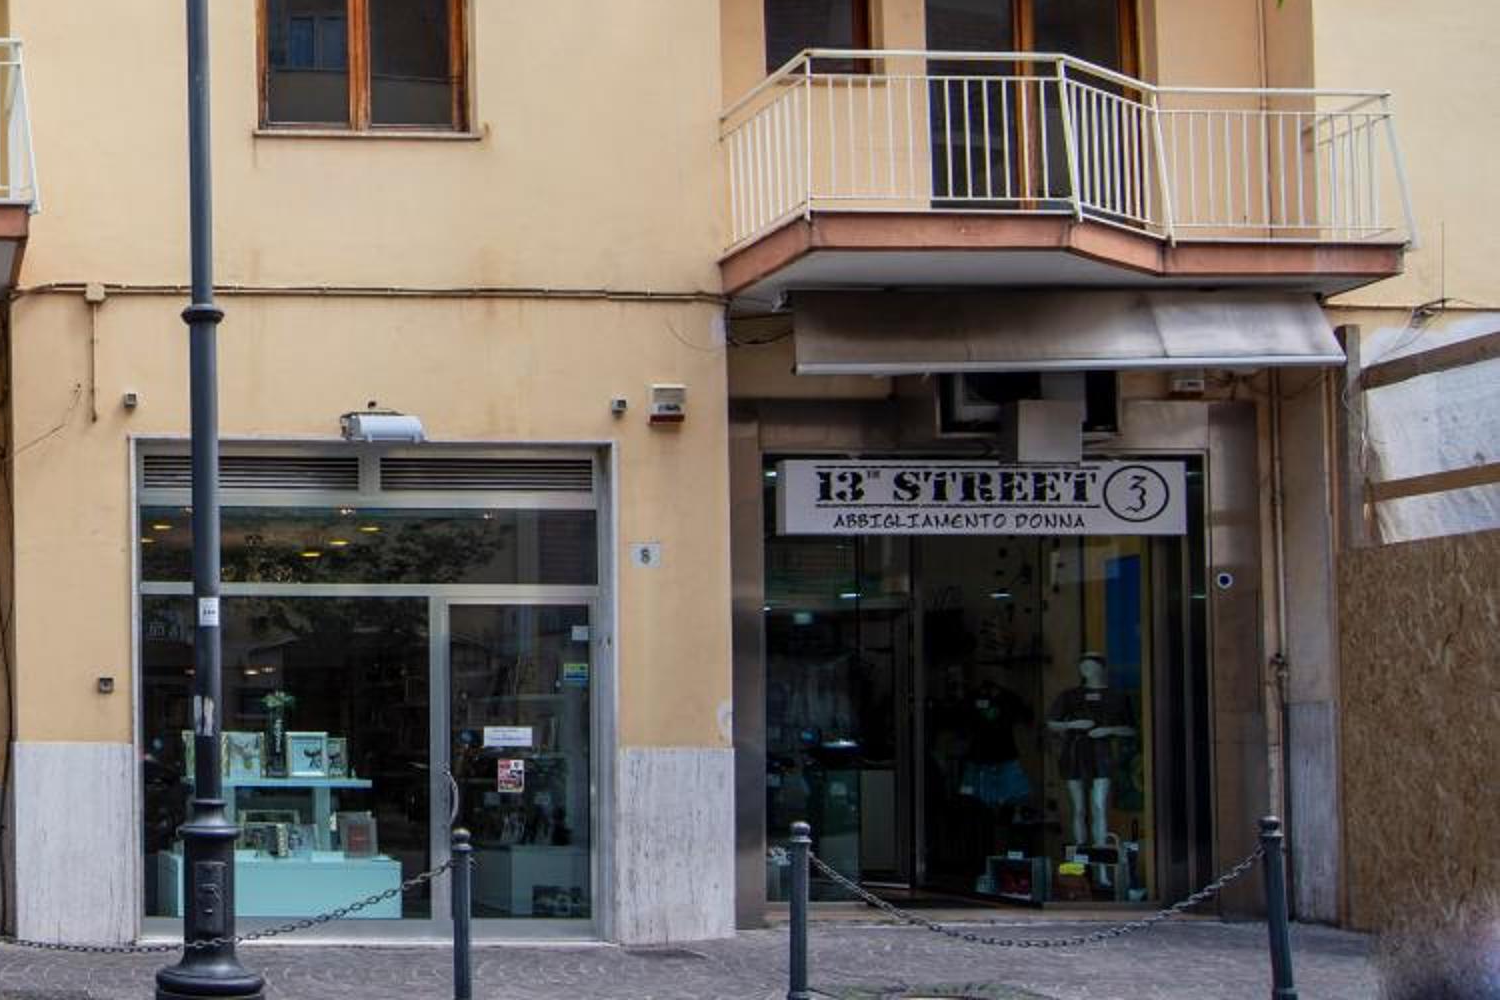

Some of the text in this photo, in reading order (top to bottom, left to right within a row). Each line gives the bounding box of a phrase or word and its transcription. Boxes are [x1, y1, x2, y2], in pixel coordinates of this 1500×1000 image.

[894, 470, 1096, 502] STREET
[833, 513, 1085, 529] ABBIGLIAMENTO DONNA
